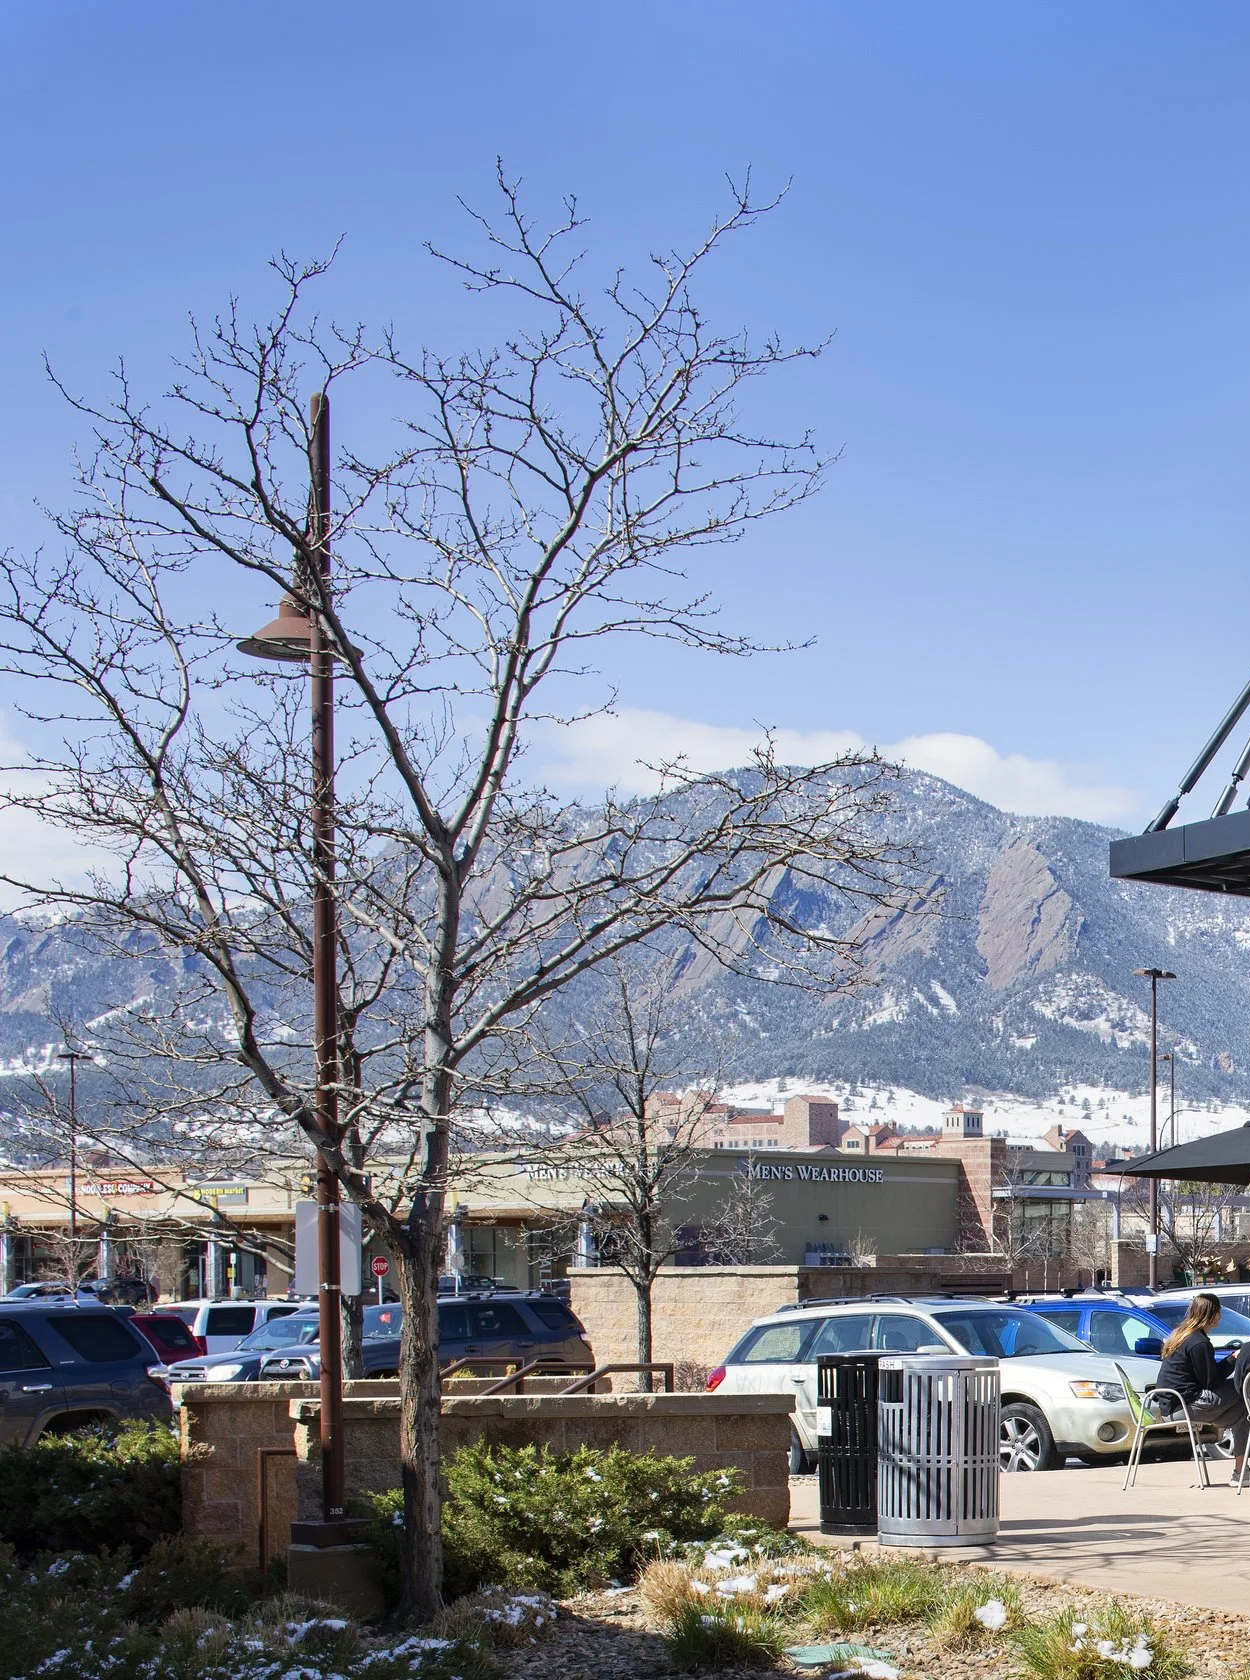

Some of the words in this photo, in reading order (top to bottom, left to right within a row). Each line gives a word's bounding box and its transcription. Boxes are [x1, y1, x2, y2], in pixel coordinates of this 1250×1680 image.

[748, 1164, 793, 1180] MEN'S
[796, 1165, 884, 1183] WEARHOUSE
[374, 1262, 388, 1271] STOP
